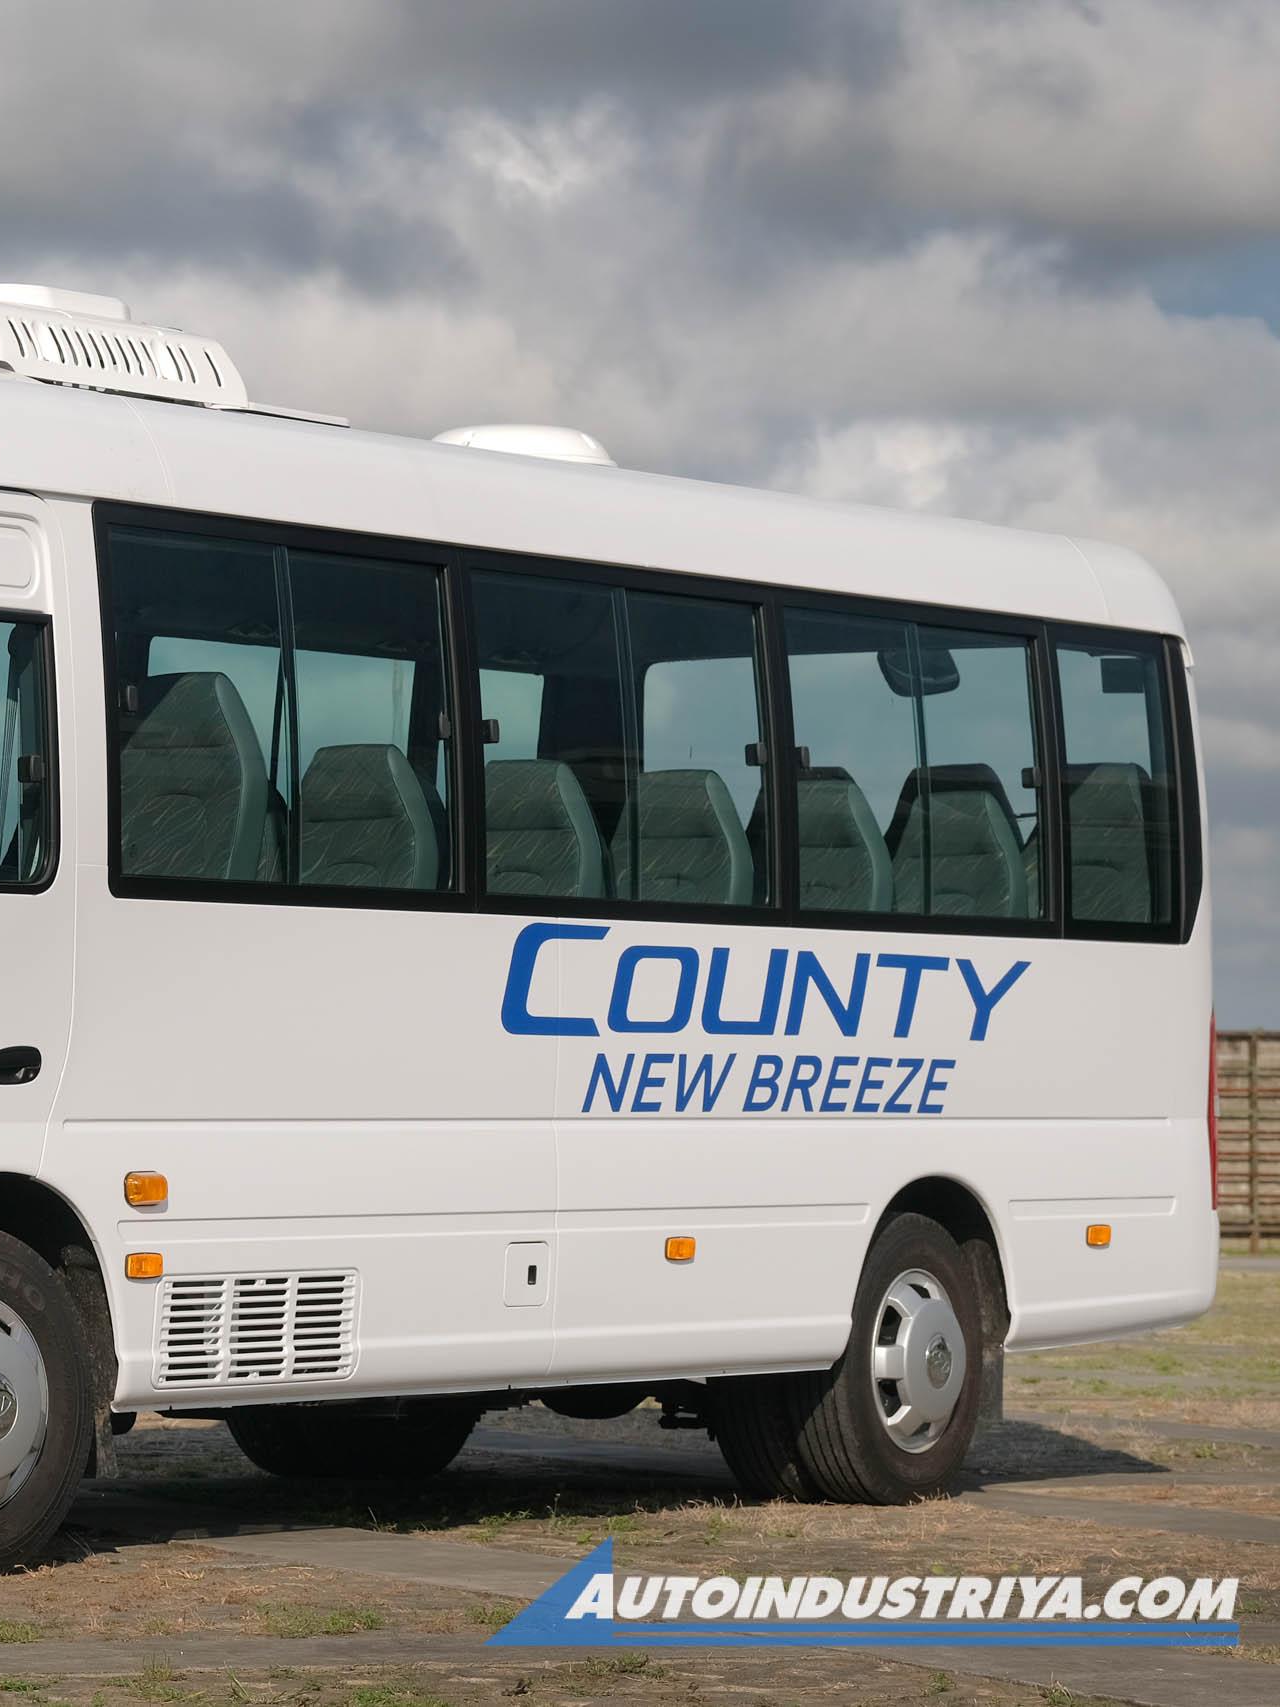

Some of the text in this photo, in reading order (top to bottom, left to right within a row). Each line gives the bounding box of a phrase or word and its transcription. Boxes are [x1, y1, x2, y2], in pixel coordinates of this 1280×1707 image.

[501, 922, 1032, 1042] COUNTY
[581, 1053, 956, 1114] NEW BREEZE
